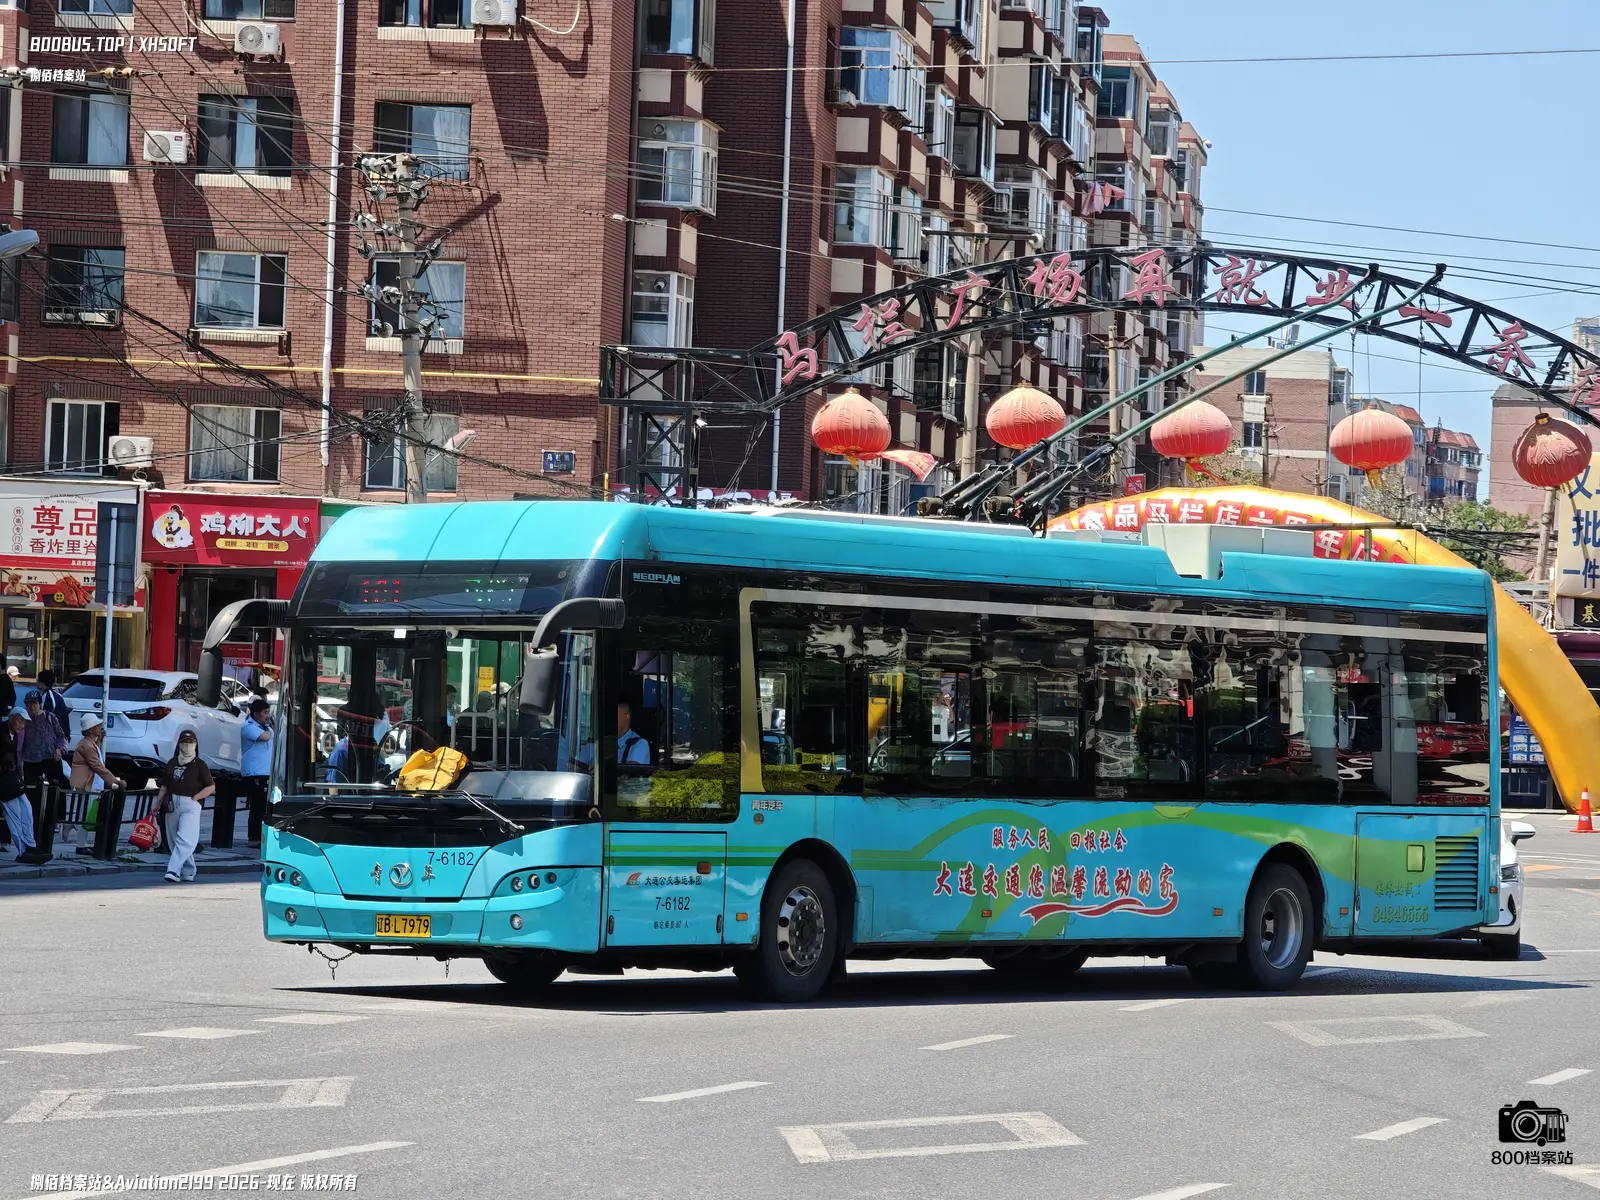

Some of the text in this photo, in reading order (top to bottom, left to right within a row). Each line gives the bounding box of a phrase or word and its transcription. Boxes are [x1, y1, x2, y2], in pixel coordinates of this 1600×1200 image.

[31, 504, 98, 536] 尊品
[200, 511, 307, 538] 鸡柳大人
[632, 572, 681, 585] NEOPLAN
[751, 799, 784, 811] 青年汽车
[991, 826, 1128, 853] 服务人民 回报社会
[427, 851, 474, 866] 7-6182
[645, 875, 702, 886] 大连公交客运集团
[933, 861, 1176, 901] 大连交通您温馨流动的家
[655, 896, 690, 911] 7-6182
